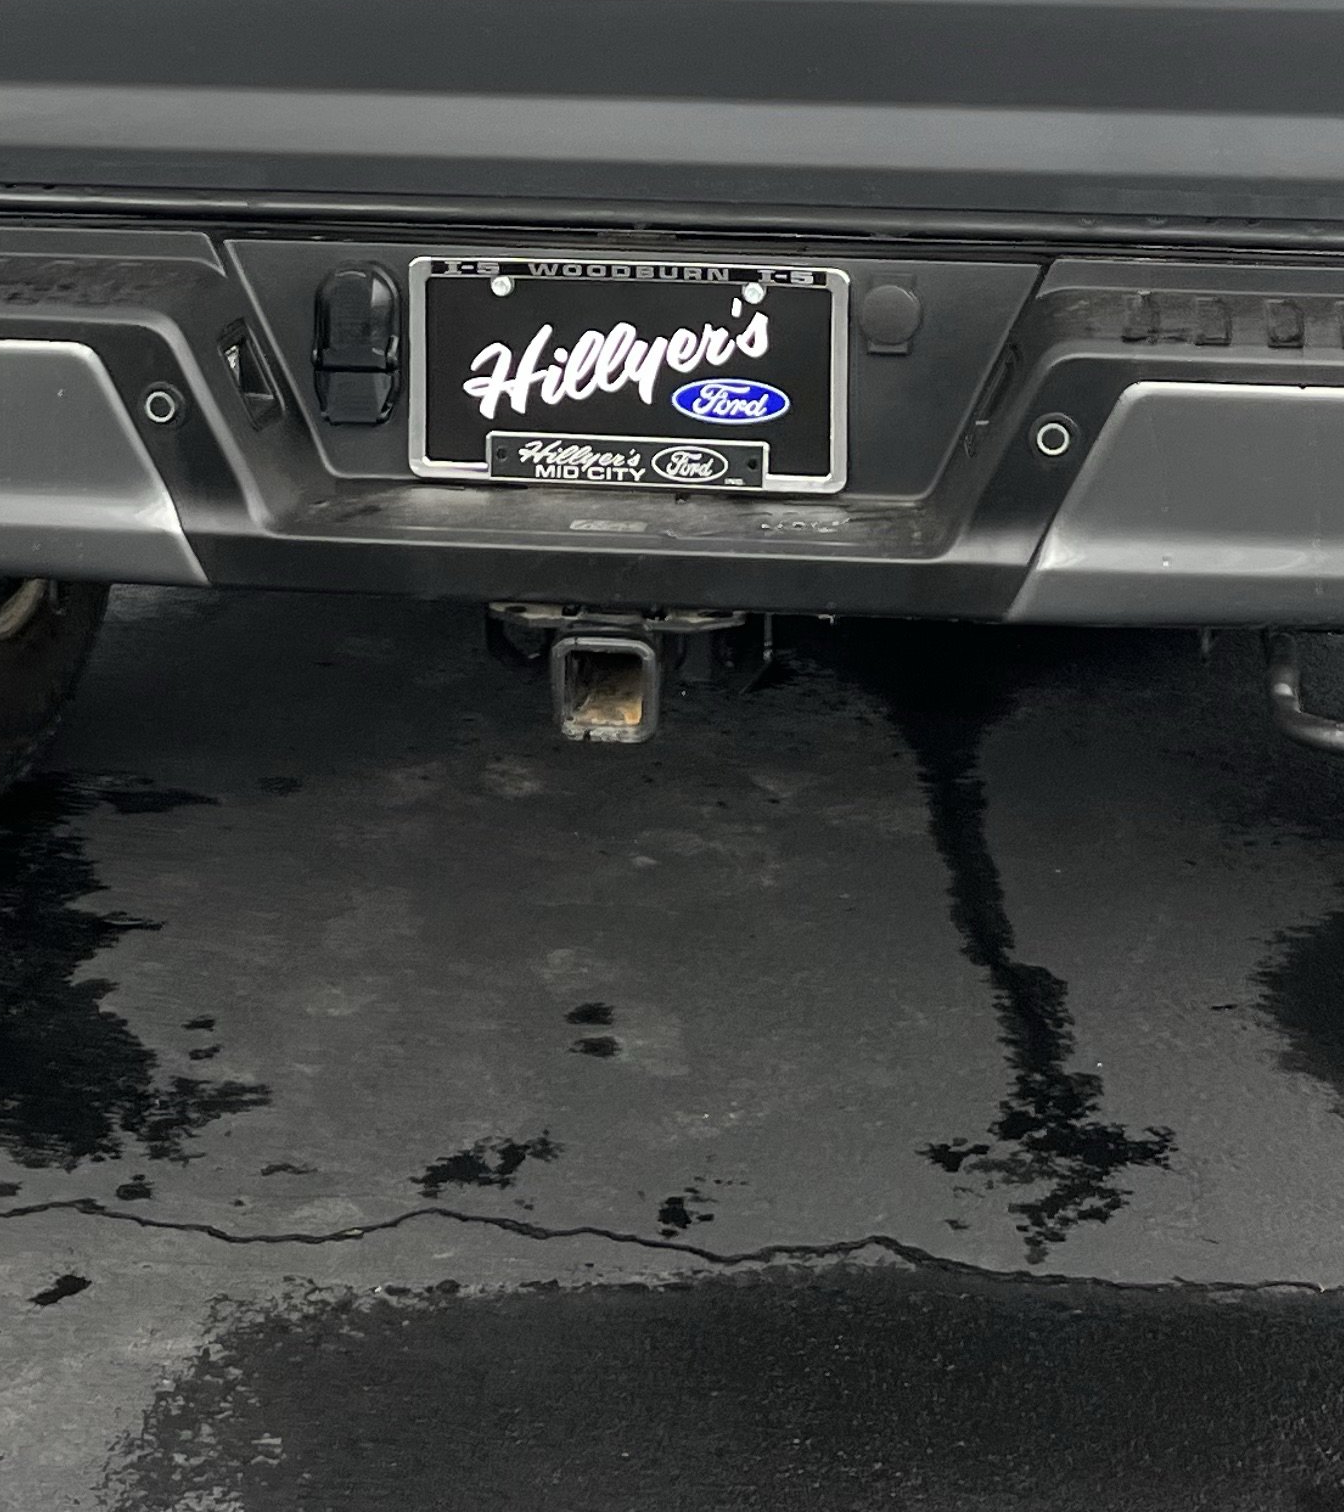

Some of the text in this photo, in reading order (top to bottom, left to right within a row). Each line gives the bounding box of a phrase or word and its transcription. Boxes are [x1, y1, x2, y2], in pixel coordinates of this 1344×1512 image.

[444, 261, 815, 284] I-5 WOODBURN I-5
[463, 297, 769, 419] Hillyer's
[692, 384, 769, 417] Ford
[518, 440, 642, 472] Hillyer's
[666, 451, 714, 478] Ford
[534, 464, 646, 482] MID CITY
